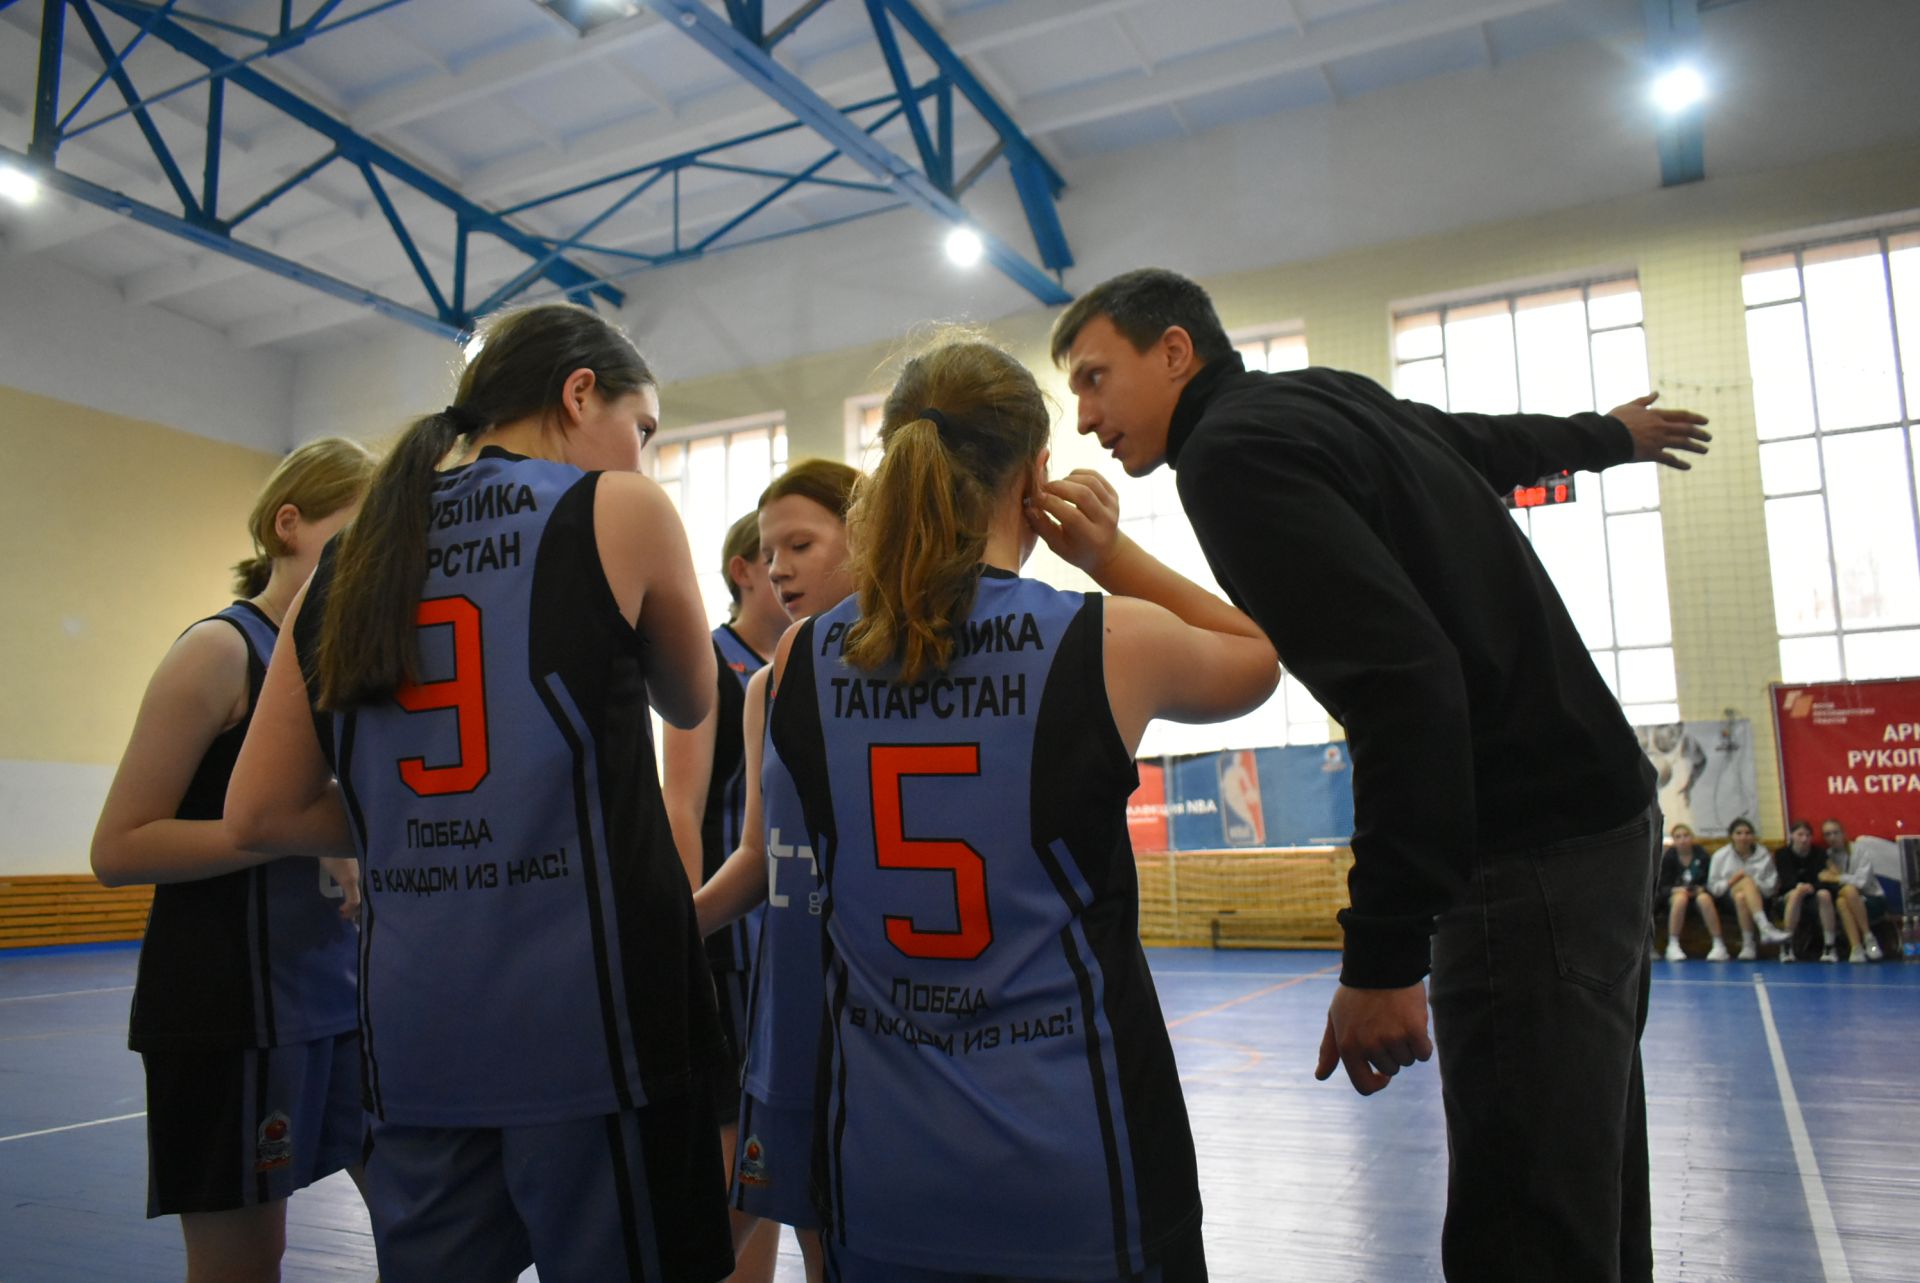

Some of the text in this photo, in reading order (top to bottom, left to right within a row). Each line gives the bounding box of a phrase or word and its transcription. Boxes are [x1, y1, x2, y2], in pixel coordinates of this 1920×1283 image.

[427, 531, 520, 578] РСТАН
[830, 673, 1026, 720] ТАТАРСТАН
[1828, 773, 1920, 795] НА СТРА
[385, 866, 458, 897] КАЖДОМ
[466, 863, 498, 890] ИЗ
[507, 848, 569, 886] НАС!
[868, 742, 994, 961] 5
[963, 1026, 1000, 1054] ИЗ
[1011, 1006, 1074, 1044] НАС!
